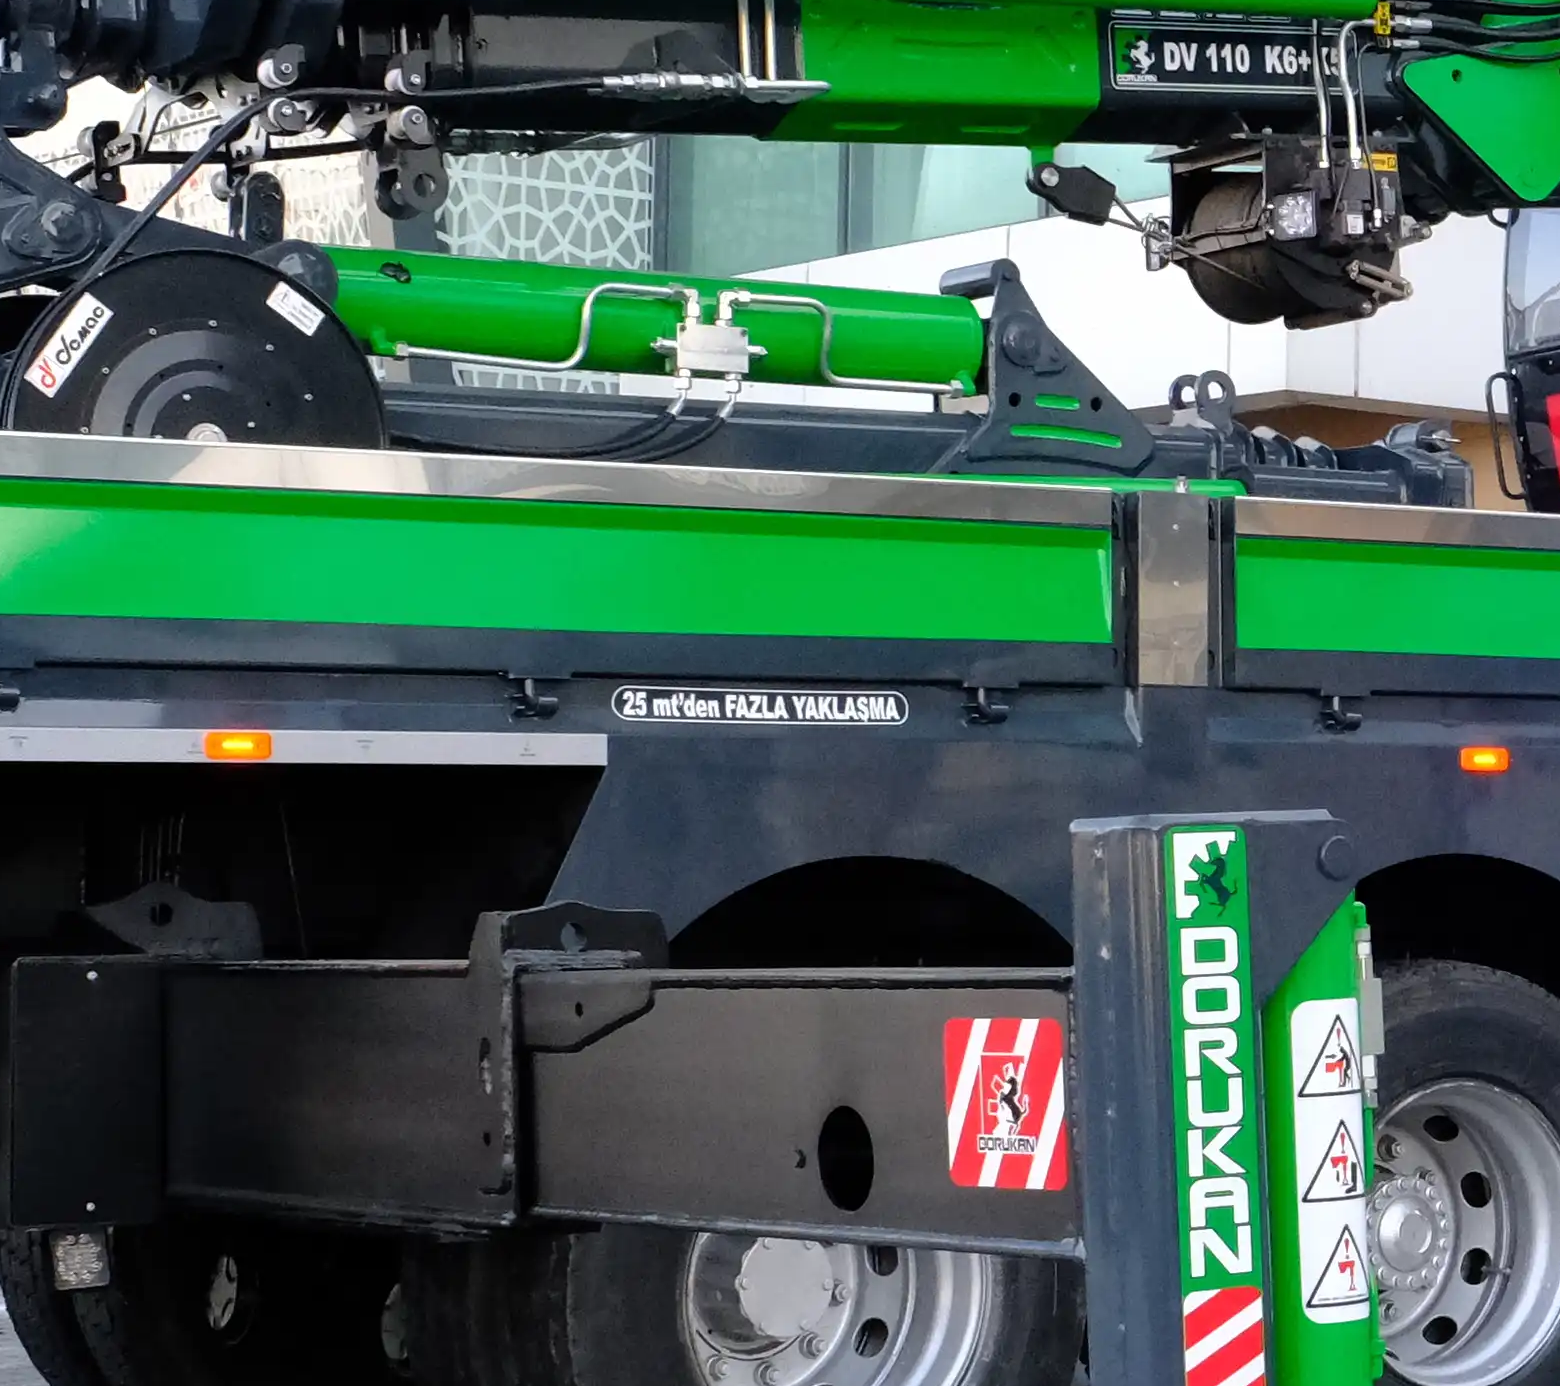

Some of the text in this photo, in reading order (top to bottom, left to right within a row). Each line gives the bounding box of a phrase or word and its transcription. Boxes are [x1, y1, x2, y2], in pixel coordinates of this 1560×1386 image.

[1163, 41, 1199, 72] DV
[1206, 43, 1250, 74] 110
[622, 691, 648, 715] 25
[725, 695, 789, 719] FAZLA
[791, 696, 900, 722] YAKLAŞMA
[1180, 926, 1253, 1278] DORUKAN
[979, 1135, 1038, 1152] DORUKAN
